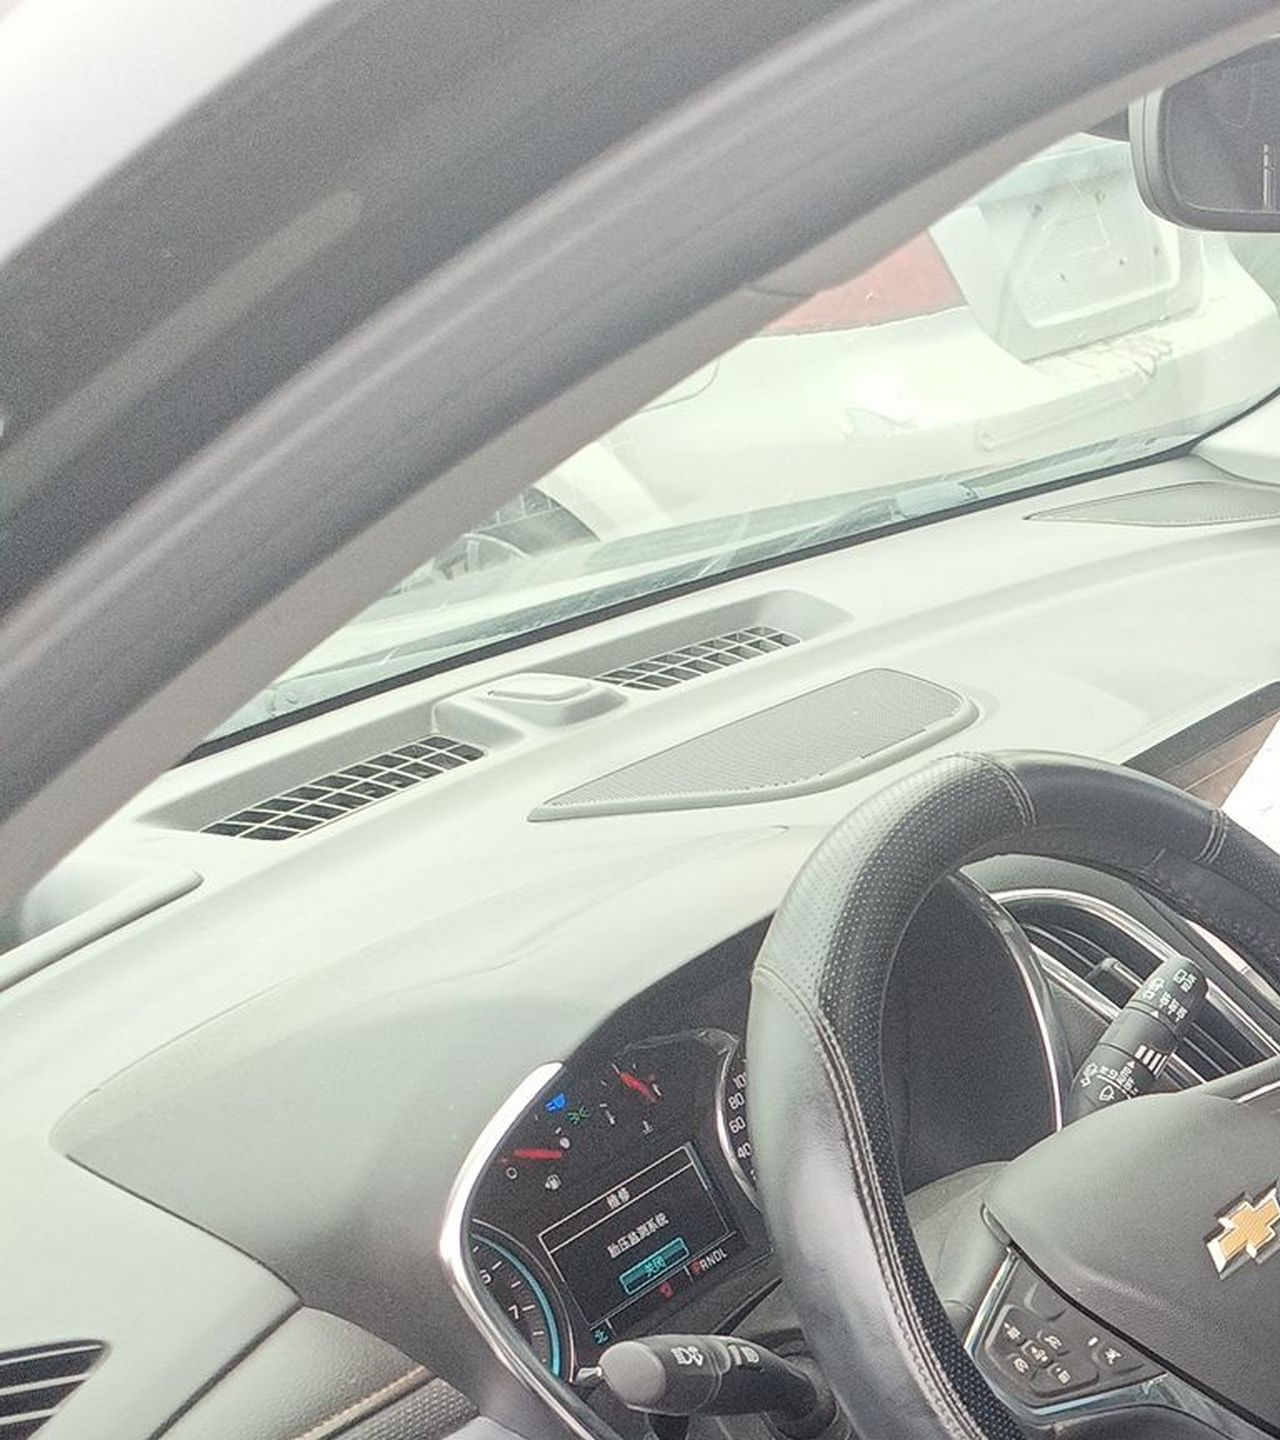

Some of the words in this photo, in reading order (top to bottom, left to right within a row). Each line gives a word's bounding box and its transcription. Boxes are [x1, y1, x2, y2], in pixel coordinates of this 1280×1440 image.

[728, 1092, 745, 1109] 80
[729, 1116, 746, 1133] 60
[737, 1142, 752, 1159] 40
[607, 1212, 669, 1258] 胎压监测系统
[508, 1304, 519, 1319] 7
